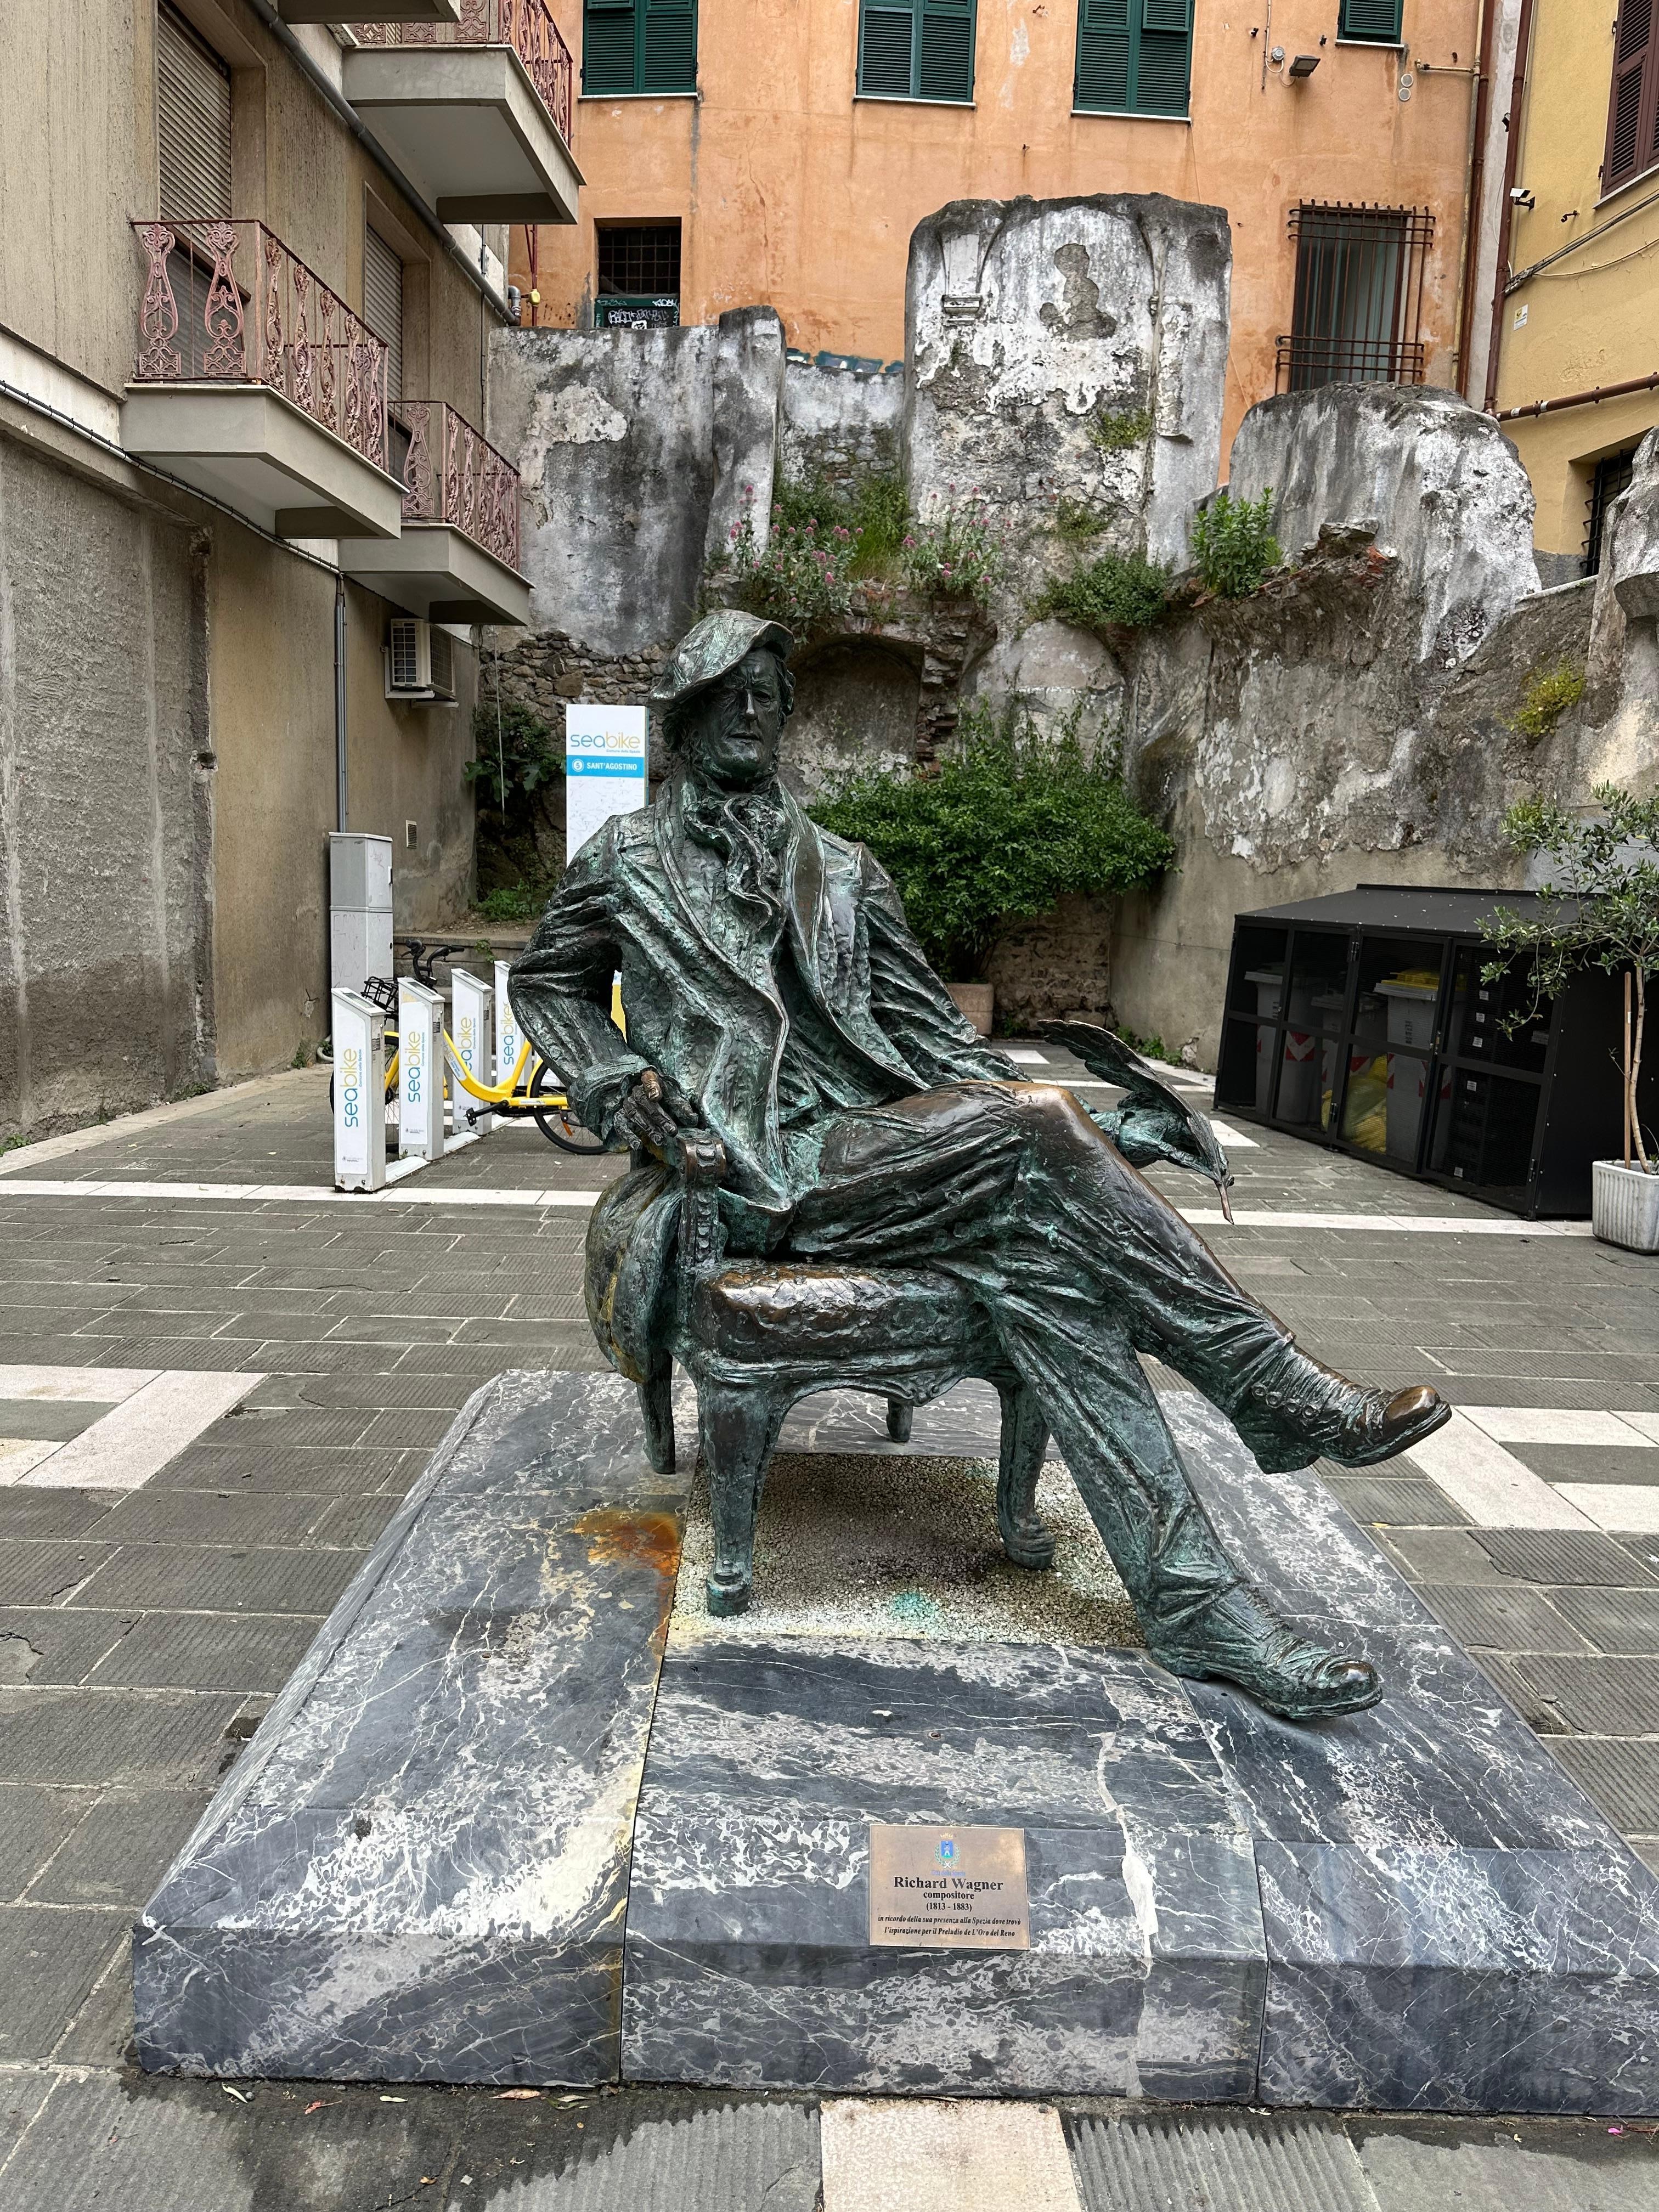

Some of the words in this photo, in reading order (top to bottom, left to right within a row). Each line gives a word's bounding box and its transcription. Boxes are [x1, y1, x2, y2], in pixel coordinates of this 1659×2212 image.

[570, 731, 640, 749] seabike
[586, 762, 637, 770] SANT'AGOSTINO
[404, 1031, 420, 1102] seabike
[340, 1048, 358, 1127] seabike
[894, 1876, 947, 1888] Richard
[951, 1878, 1003, 1892] Wagner
[923, 1891, 974, 1900] compositore
[926, 1902, 946, 1911] (1813
[953, 1903, 972, 1912] 1883)
[972, 1917, 991, 1926] Spezia
[884, 1927, 921, 1936] l'ispirazione
